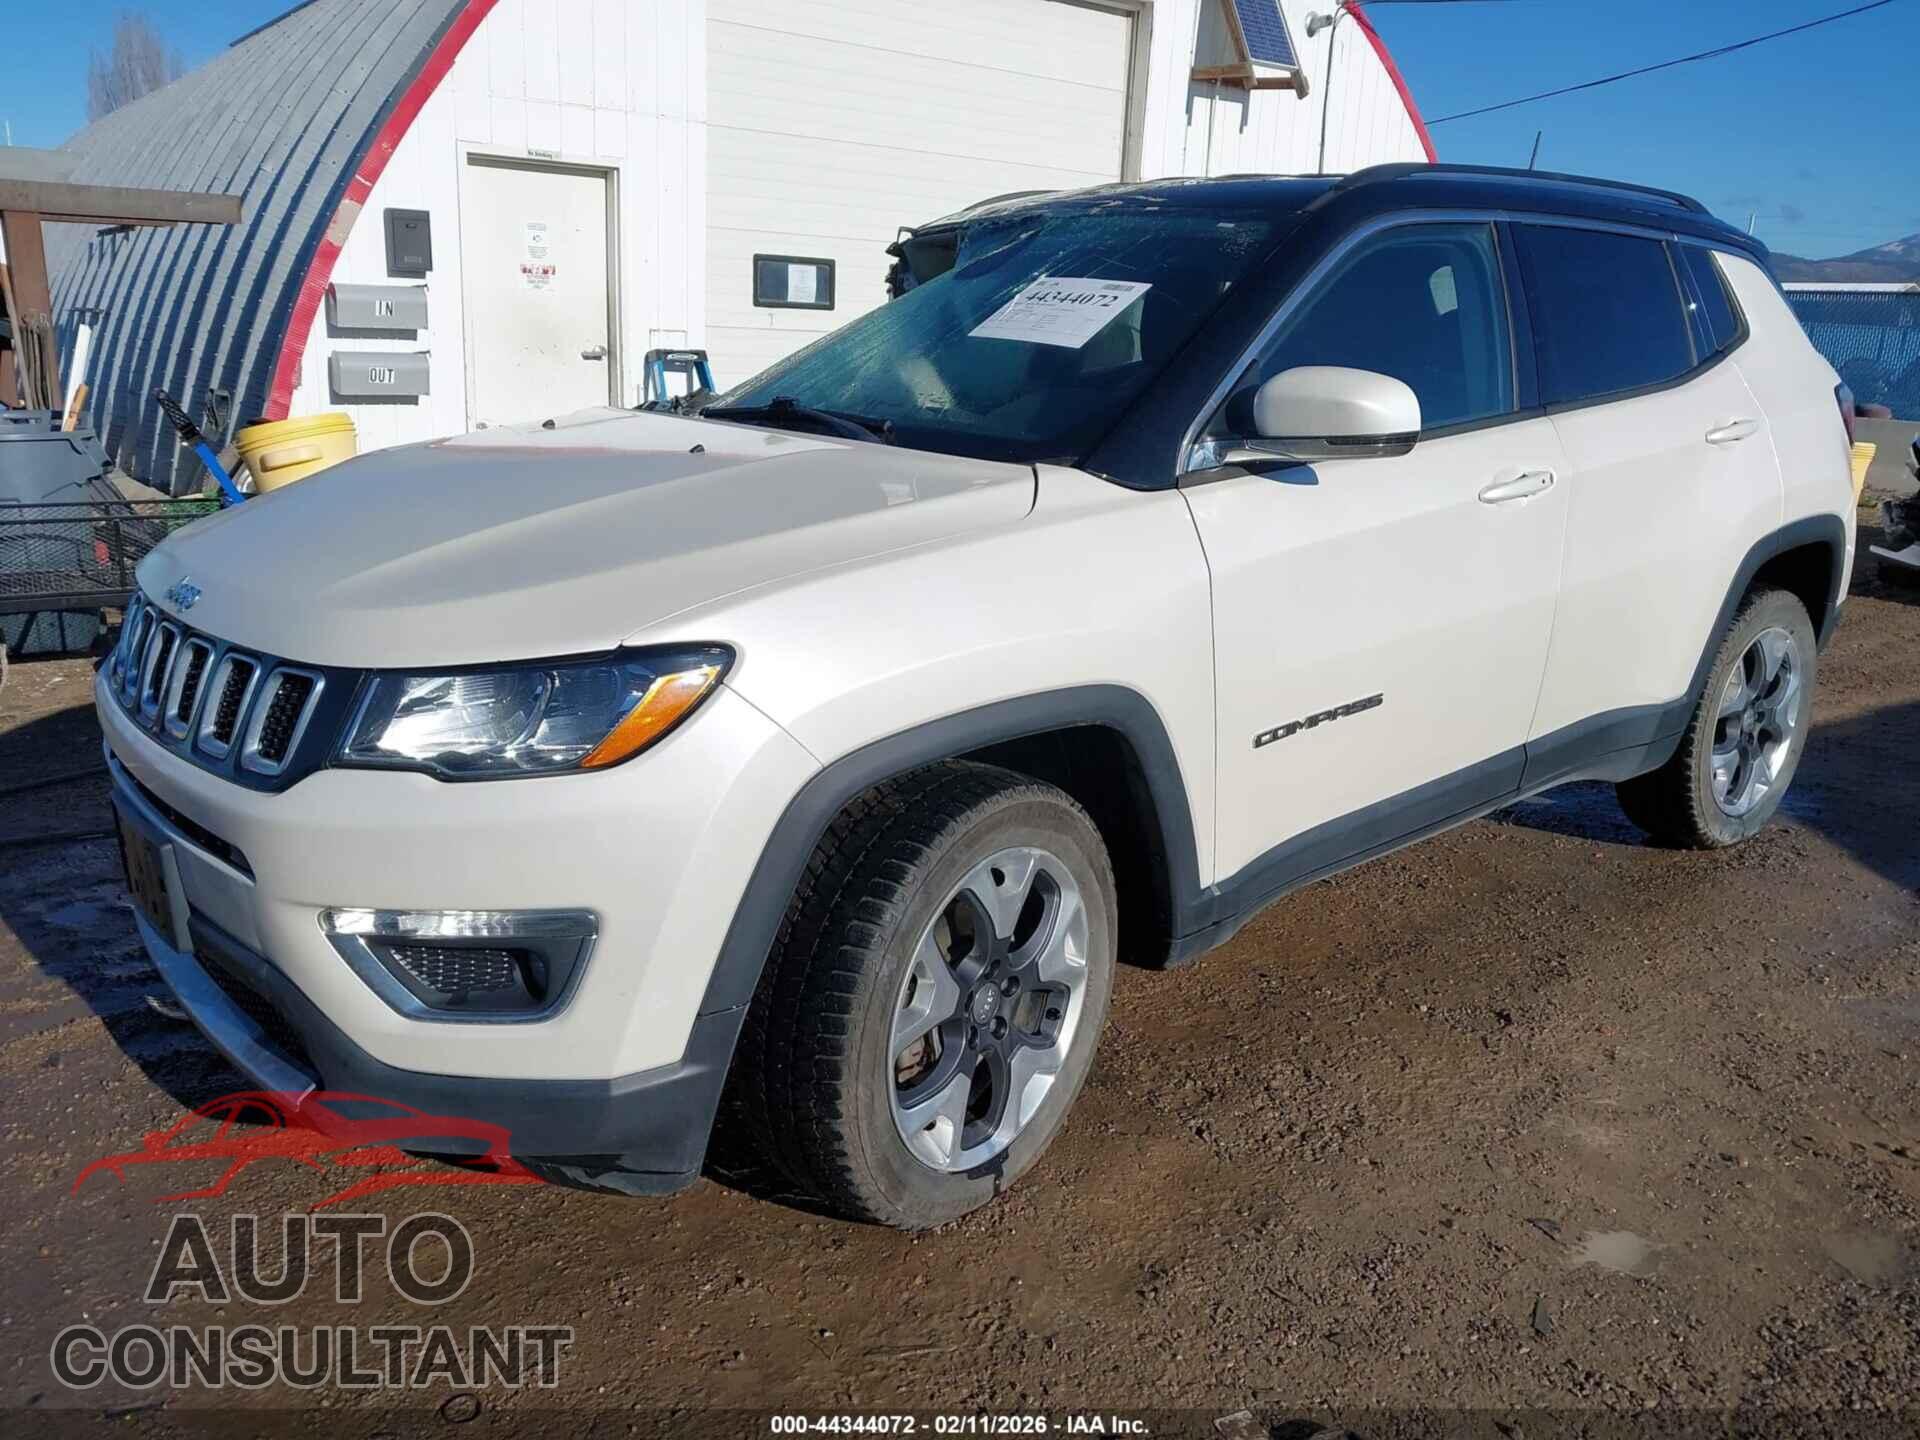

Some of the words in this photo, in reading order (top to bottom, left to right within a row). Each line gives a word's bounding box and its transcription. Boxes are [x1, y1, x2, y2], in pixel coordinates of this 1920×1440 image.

[1026, 291, 1119, 307] 44344072
[379, 301, 394, 317] IN
[370, 368, 394, 382] OUT
[1253, 692, 1384, 748] COMPASS
